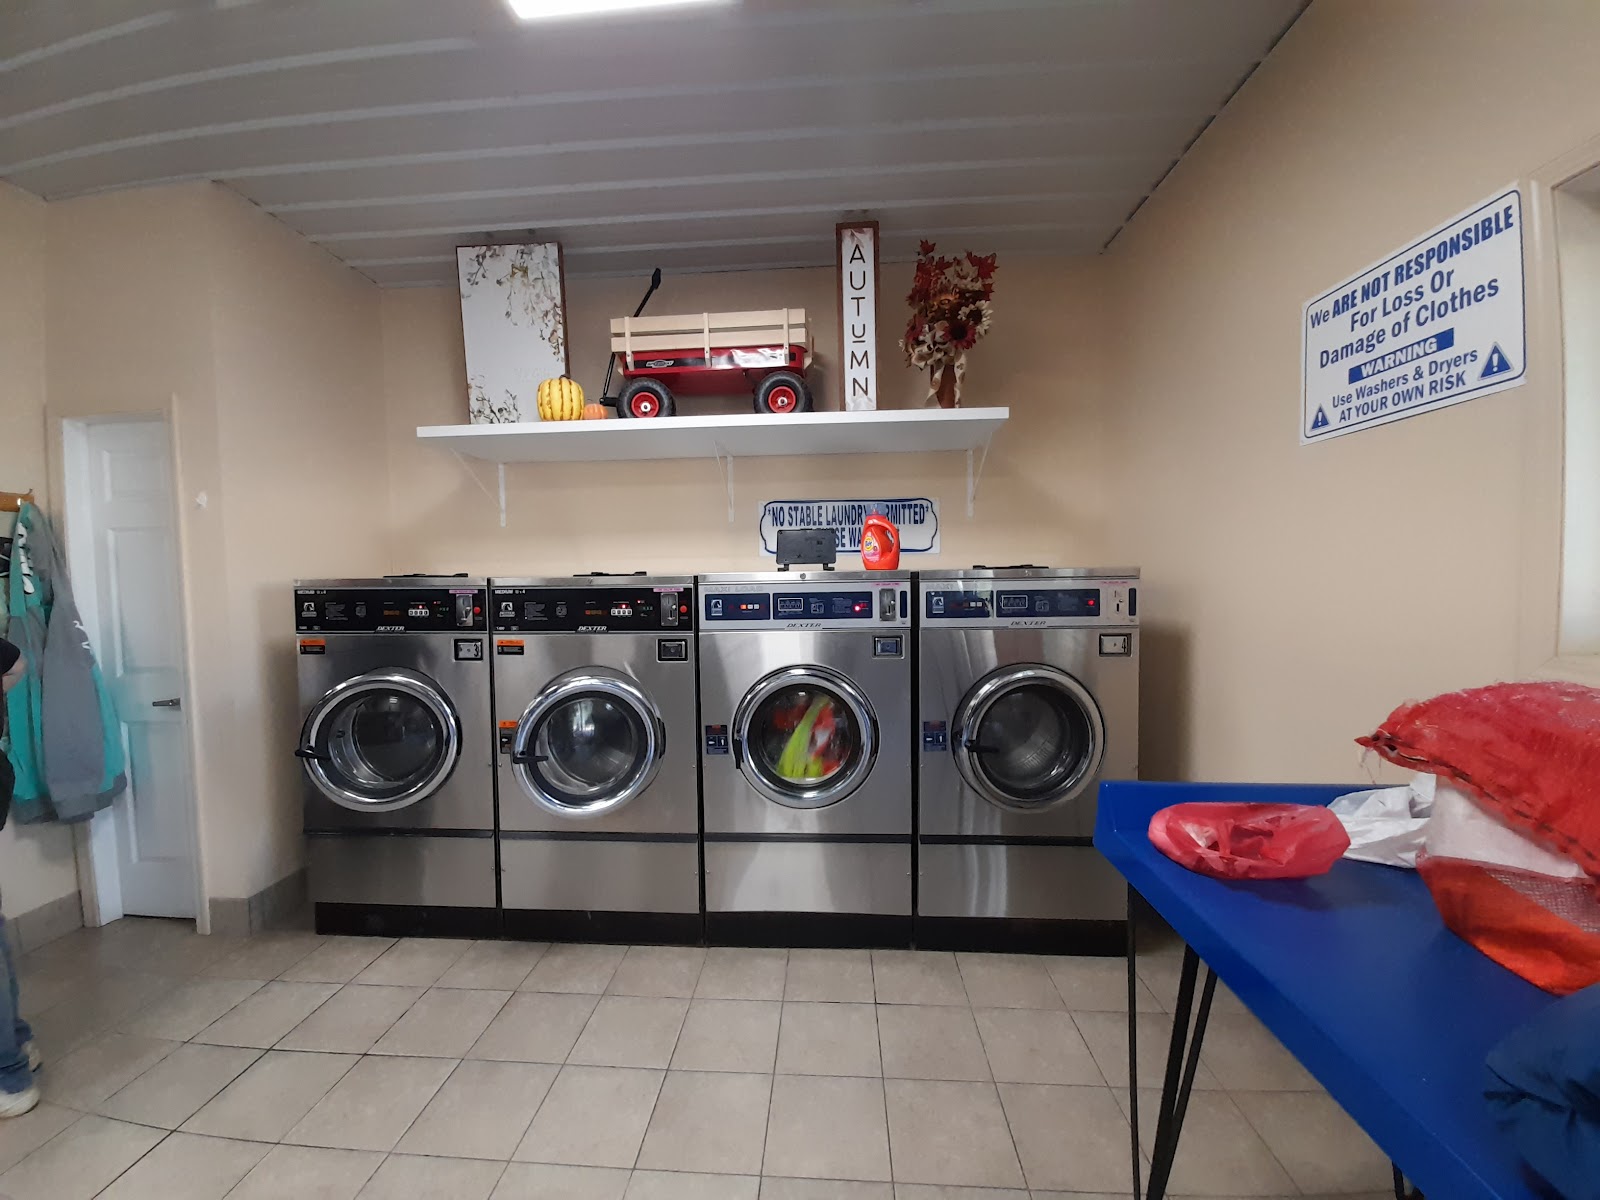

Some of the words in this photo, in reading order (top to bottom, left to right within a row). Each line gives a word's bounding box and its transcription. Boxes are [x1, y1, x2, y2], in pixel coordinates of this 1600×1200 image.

[1310, 309, 1330, 329] We
[1332, 289, 1357, 318] ARE
[1361, 271, 1390, 304] NOT
[1395, 205, 1514, 287] RESPONSIBLE
[849, 243, 869, 397] AUTUMN
[1320, 328, 1386, 368] Damage
[1392, 315, 1411, 338] of
[1416, 278, 1499, 327] Clothes
[1351, 307, 1377, 332] For
[1383, 285, 1424, 317] Loss
[1431, 268, 1454, 293] Or
[1333, 393, 1352, 408] Use
[1356, 372, 1408, 400] Washers
[1413, 365, 1424, 381] &
[1429, 349, 1478, 377] Dryers
[1360, 337, 1437, 378] WARNING
[1339, 408, 1353, 423] AT
[1353, 396, 1388, 419] YOUR
[1392, 384, 1424, 406] OWN
[1429, 370, 1466, 394] RISK
[787, 505, 823, 526] STABLE
